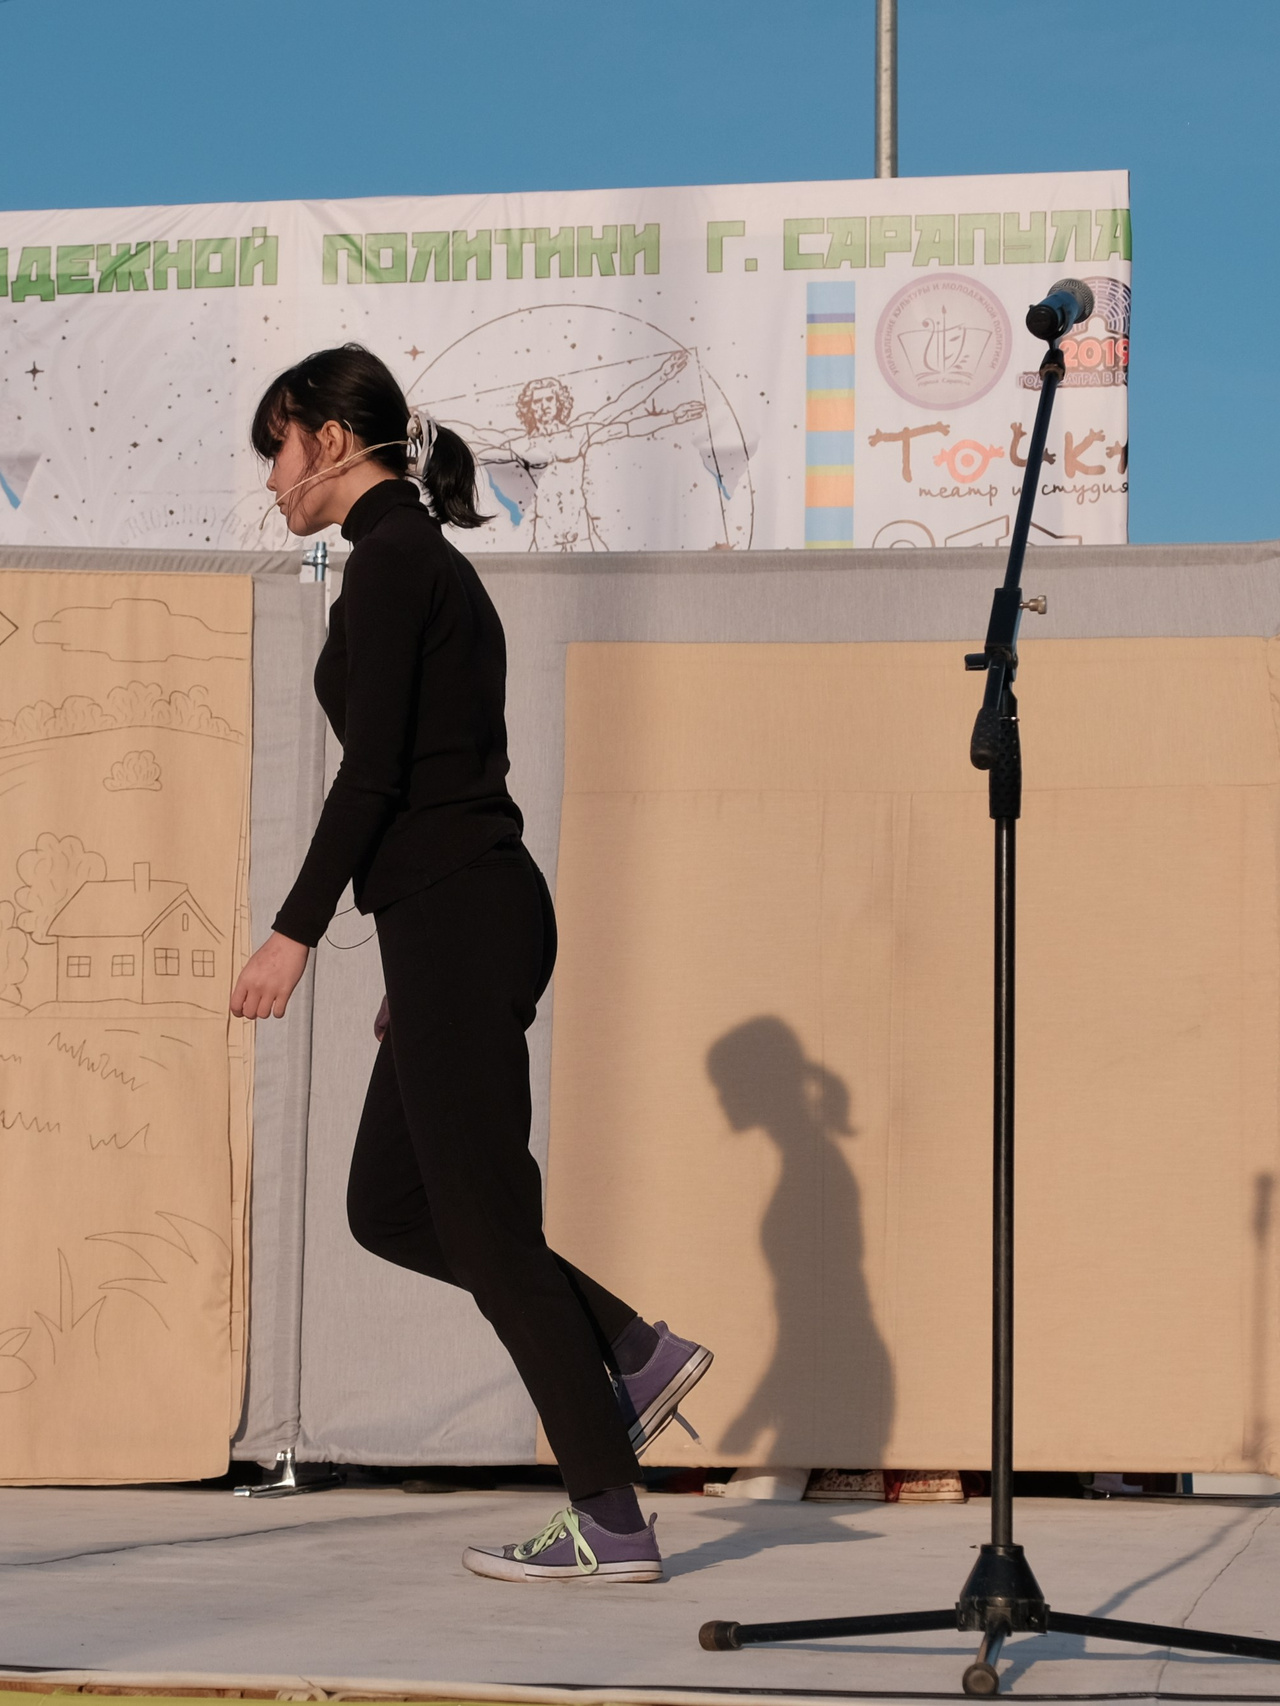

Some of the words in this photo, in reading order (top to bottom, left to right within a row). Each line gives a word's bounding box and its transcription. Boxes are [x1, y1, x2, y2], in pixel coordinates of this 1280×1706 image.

[322, 222, 660, 285] ПОЛИТИКИ
[706, 219, 758, 273] Г.
[783, 208, 1132, 271] САРАПУЛА
[883, 317, 900, 377] УПРАВЛЕНИЕ
[892, 285, 931, 319] КУЛЬТУРЫ
[932, 283, 940, 291] И
[989, 317, 1004, 370] ПОЛИТИКИ
[1058, 338, 1129, 368] 2019
[919, 484, 998, 506] театр
